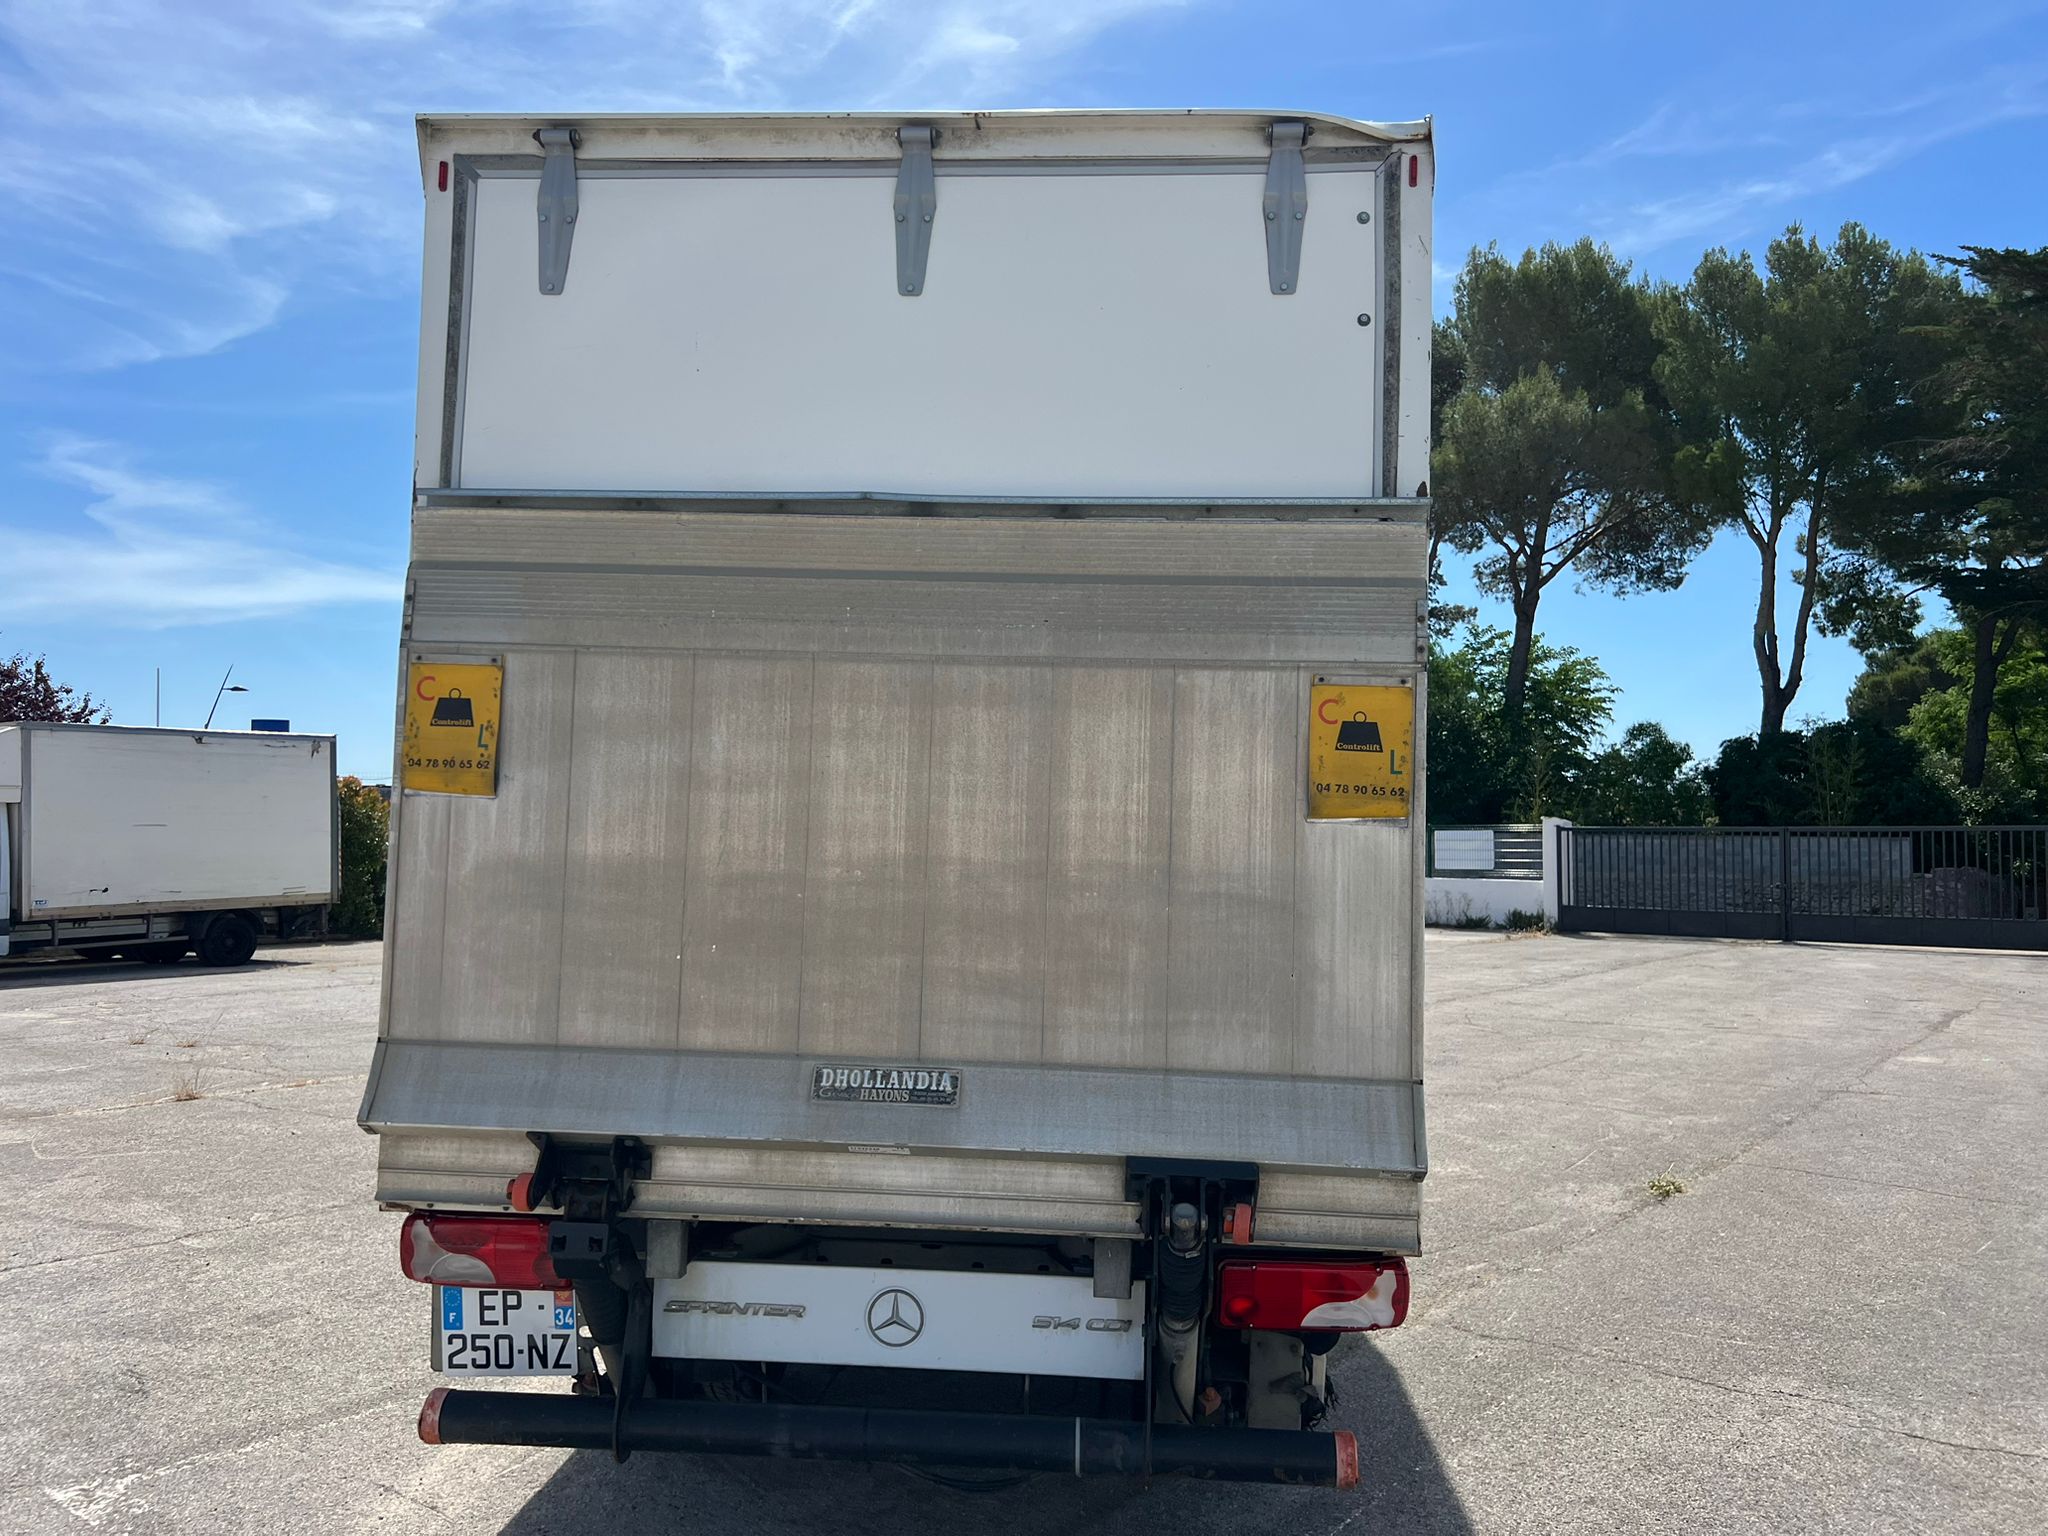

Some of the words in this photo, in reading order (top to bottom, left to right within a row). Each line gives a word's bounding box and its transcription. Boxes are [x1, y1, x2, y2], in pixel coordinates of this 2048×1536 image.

[431, 718, 472, 726] Controlift
[1336, 742, 1382, 752] Controlift
[408, 758, 421, 767] 04
[426, 759, 439, 768] 78
[442, 759, 455, 768] 90
[459, 760, 472, 769] 65
[476, 760, 490, 769] 62
[1316, 783, 1331, 793] 04
[1335, 784, 1349, 794] 78
[1353, 785, 1367, 795] 90
[1371, 786, 1386, 796] 65
[1390, 787, 1405, 797] 62
[820, 1068, 953, 1092] DHOLLANDIA
[859, 1088, 910, 1102] HAYONS
[663, 1300, 806, 1318] SPRINTER
[449, 1312, 457, 1323] F
[555, 1308, 574, 1326] 34
[1032, 1315, 1081, 1330] 514
[1085, 1318, 1133, 1332] CDI
[447, 1333, 572, 1370] 250-NZ
